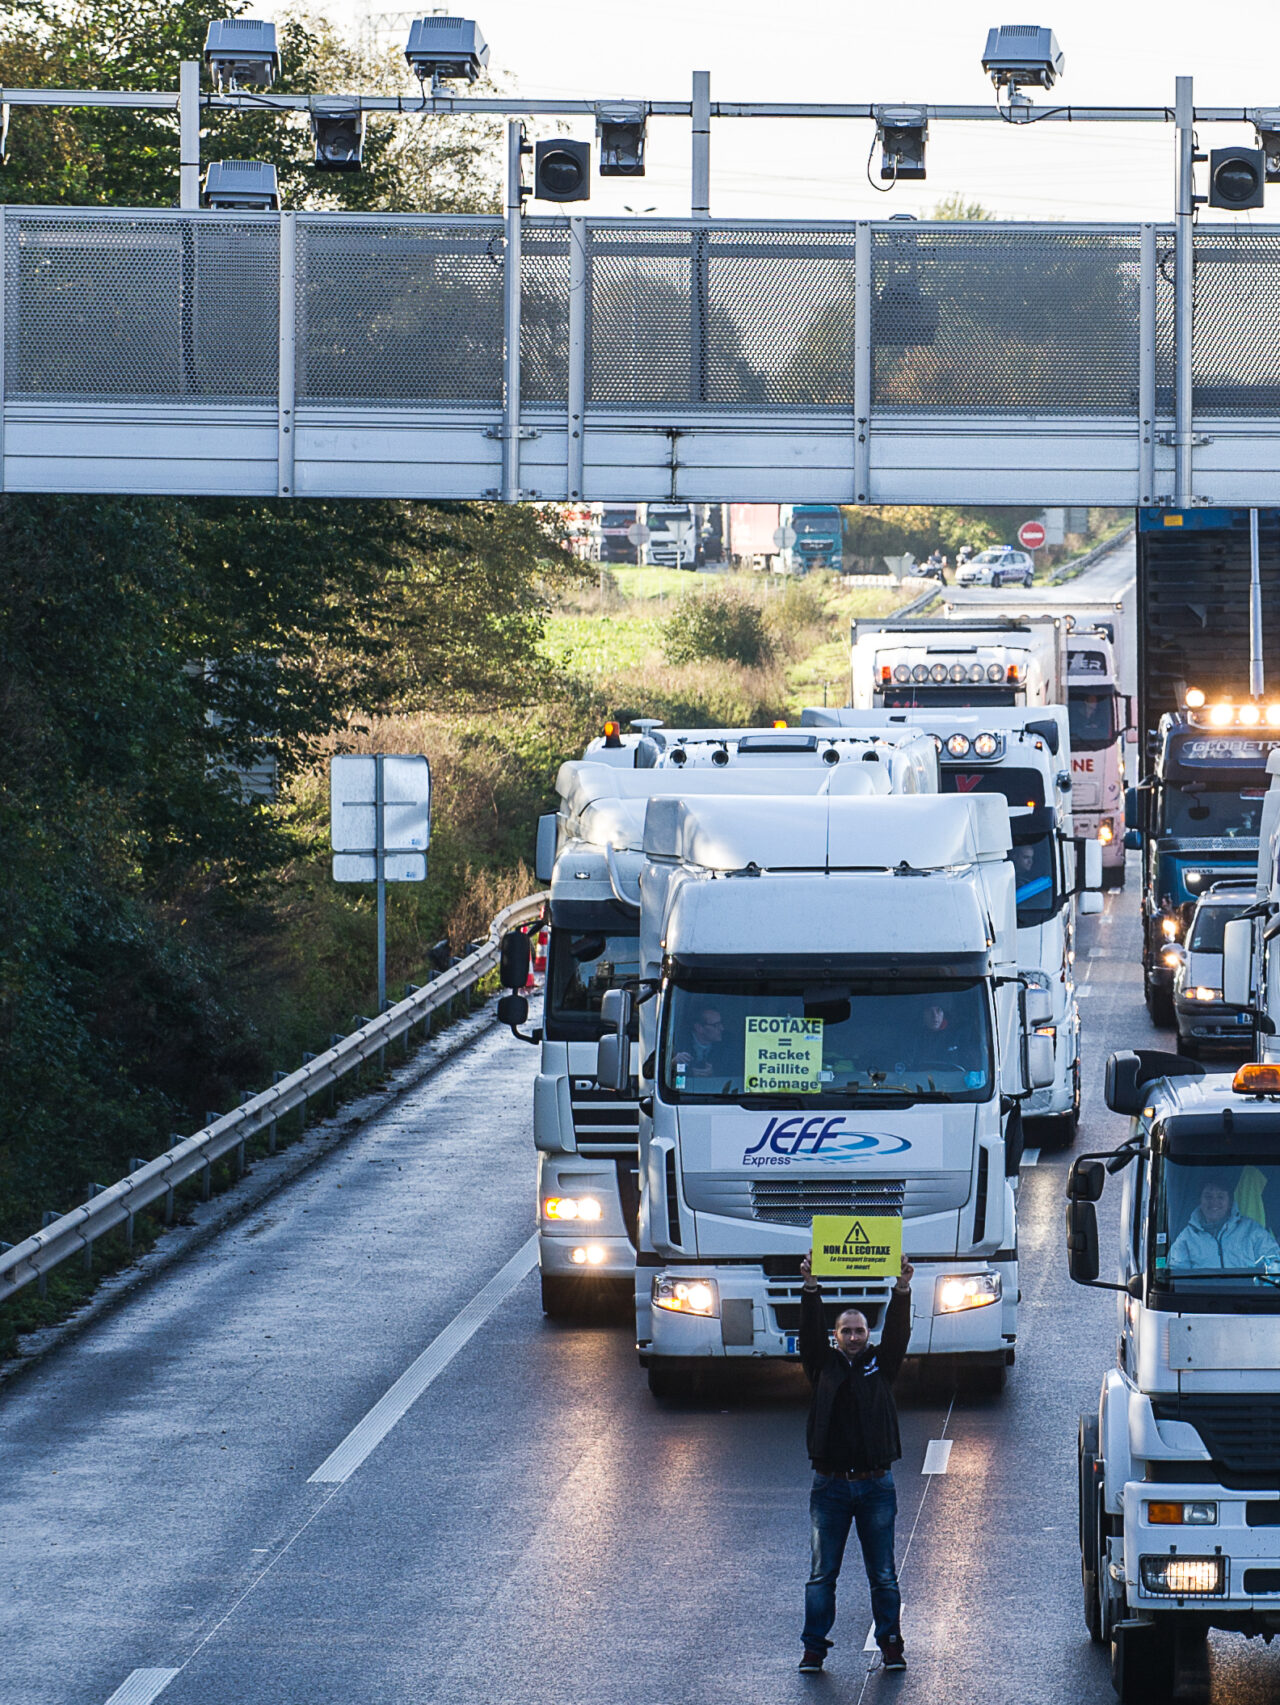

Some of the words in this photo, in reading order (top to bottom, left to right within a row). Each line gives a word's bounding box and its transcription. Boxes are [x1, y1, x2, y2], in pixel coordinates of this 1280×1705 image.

[748, 1019, 821, 1034] ECOTAXE
[758, 1049, 811, 1061] Racket
[758, 1063, 809, 1075] Faillite
[748, 1077, 819, 1092] Chômage
[745, 1117, 847, 1155] JEFF
[742, 1154, 791, 1168] Express
[824, 1246, 840, 1255] NON
[855, 1246, 890, 1255] ECOTAXE
